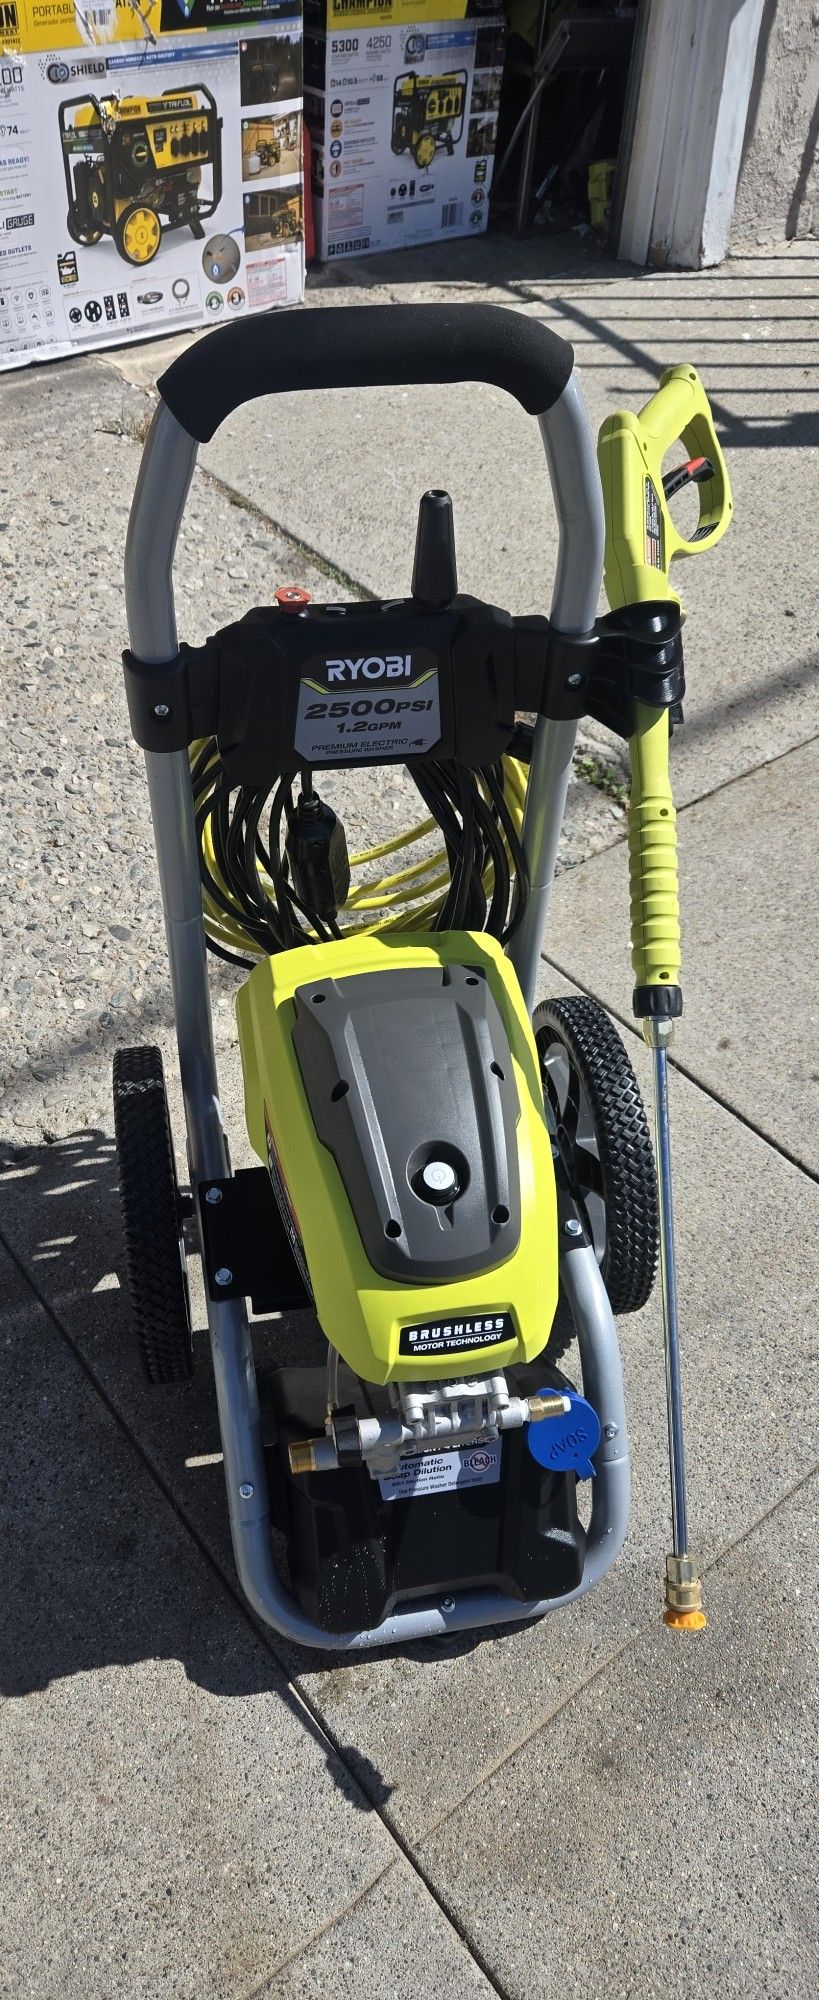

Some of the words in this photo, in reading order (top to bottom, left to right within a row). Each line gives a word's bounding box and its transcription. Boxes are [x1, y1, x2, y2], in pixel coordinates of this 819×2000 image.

[33, 4, 75, 17] PORTABL
[332, 38, 359, 53] 5300
[366, 35, 392, 49] 4250
[0, 66, 23, 85] 00
[71, 63, 105, 76] SHIELD
[7, 125, 19, 136] 74
[8, 156, 30, 165] READY!
[8, 245, 32, 255] OUTLETS
[325, 655, 412, 682] RYOBI
[304, 698, 434, 720] 2500PSI
[336, 720, 402, 734] 1.2GPM
[311, 742, 359, 751] PREMIUM
[360, 738, 409, 748] ELECTRIC
[364, 745, 394, 753] WASHER
[408, 1318, 505, 1342] BRUSHLESS
[413, 1340, 450, 1352] MOTOR
[450, 1332, 502, 1347] TECHNOLOGY
[463, 1455, 497, 1468] BLEACH
[413, 1464, 452, 1475] Dilution
[430, 1482, 447, 1490] Washer
